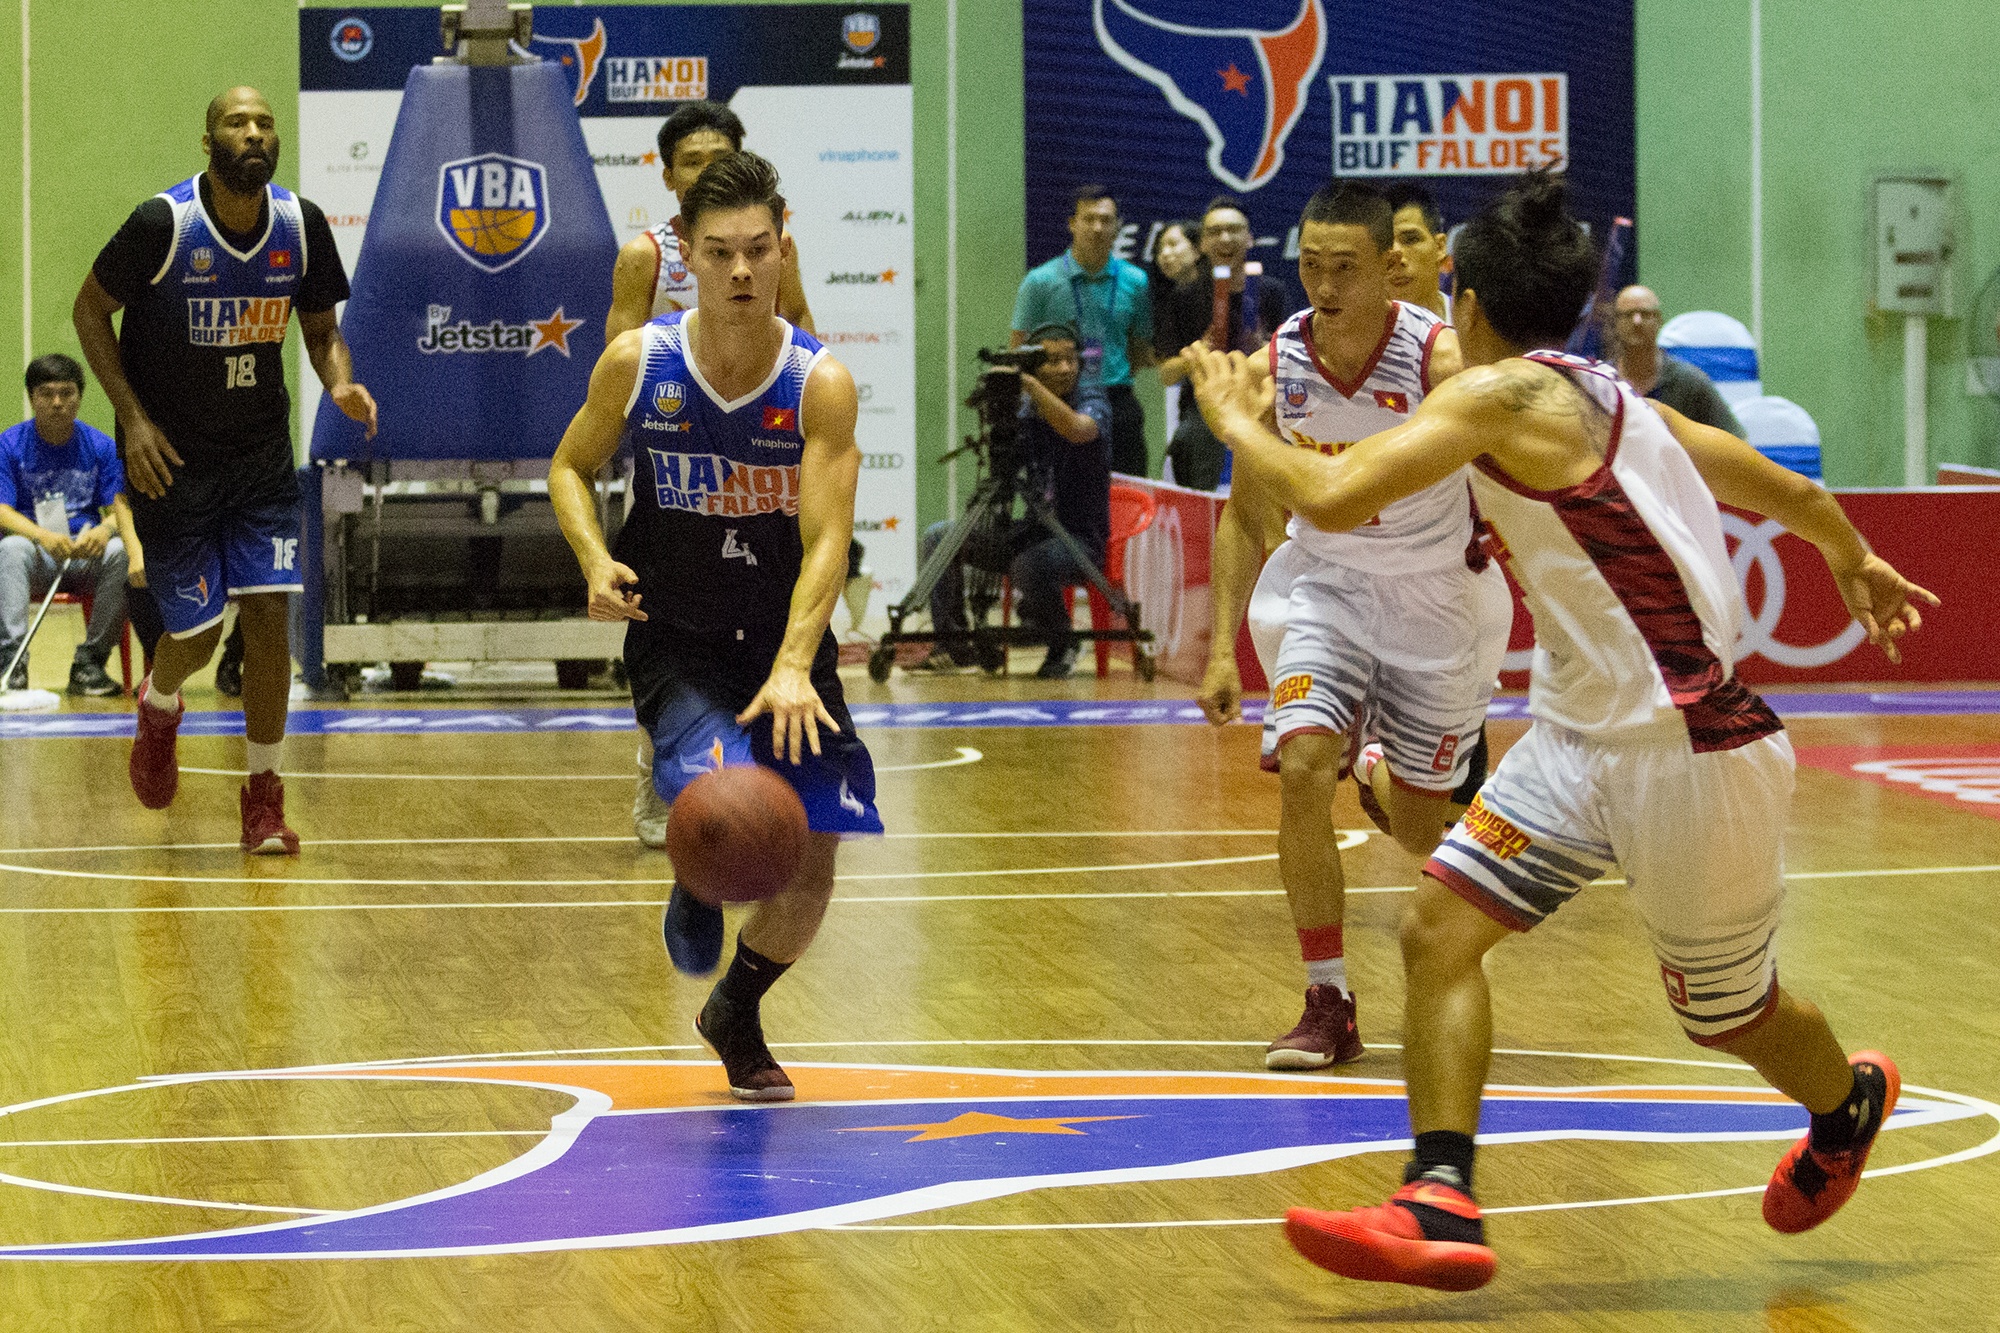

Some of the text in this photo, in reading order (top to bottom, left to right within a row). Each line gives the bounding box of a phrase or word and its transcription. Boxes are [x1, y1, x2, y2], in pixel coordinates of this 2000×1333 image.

[609, 60, 705, 84] HANOI
[610, 84, 706, 99] BUFFALOES
[1335, 79, 1560, 135] HANOI
[592, 154, 641, 167] etstar
[1338, 139, 1562, 171] BUFFALOES
[450, 162, 537, 208] VBA
[191, 297, 290, 328] HANOI
[430, 306, 450, 322] By
[420, 323, 536, 350] Jetstar
[225, 354, 257, 389] 18
[658, 384, 683, 398] VBA
[641, 419, 680, 432] Jetstar
[653, 453, 800, 496] HANOI
[721, 529, 758, 566] 4
[1464, 802, 1532, 853] SAIGON
[1465, 824, 1520, 861] HEAT
